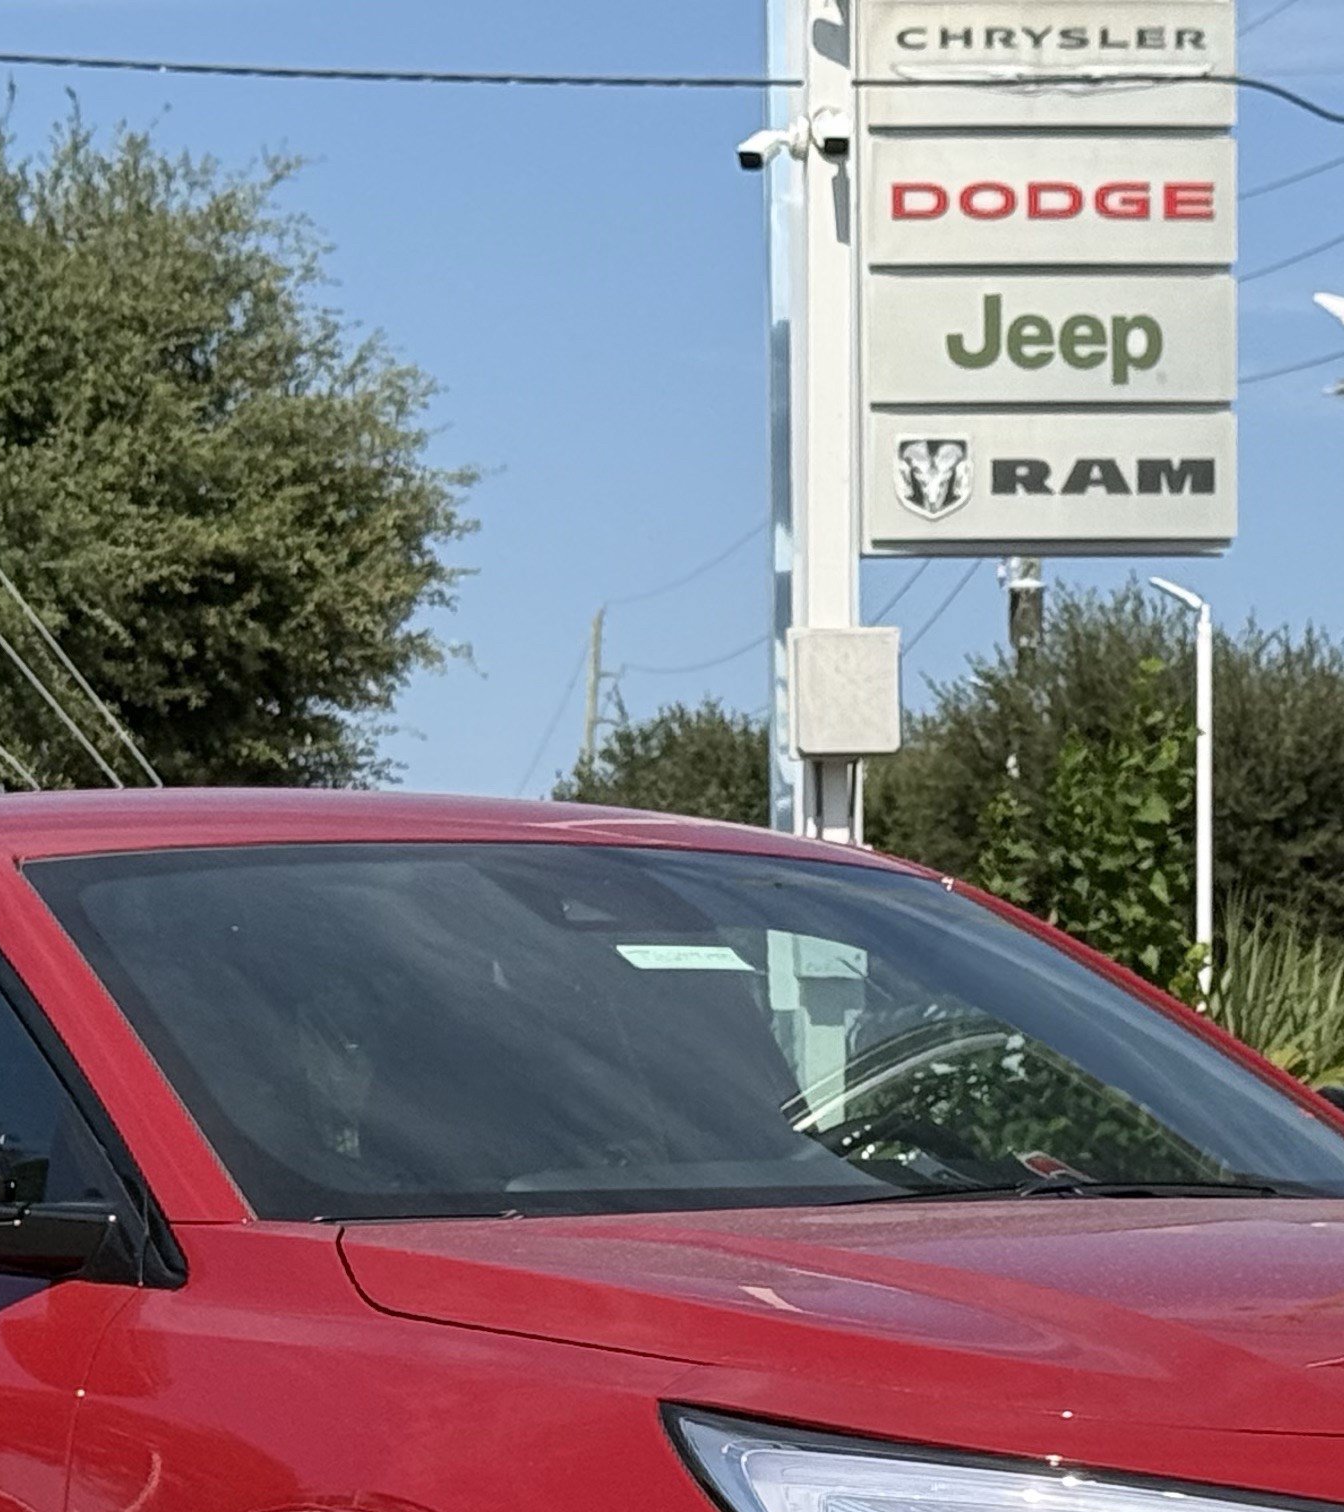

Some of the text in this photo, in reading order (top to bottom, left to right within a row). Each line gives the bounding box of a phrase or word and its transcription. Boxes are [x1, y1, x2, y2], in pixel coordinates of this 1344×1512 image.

[895, 26, 1208, 50] CHRYSLER
[891, 181, 1215, 221] DODGE
[946, 293, 1163, 385] Jeep
[990, 458, 1216, 496] RAM
